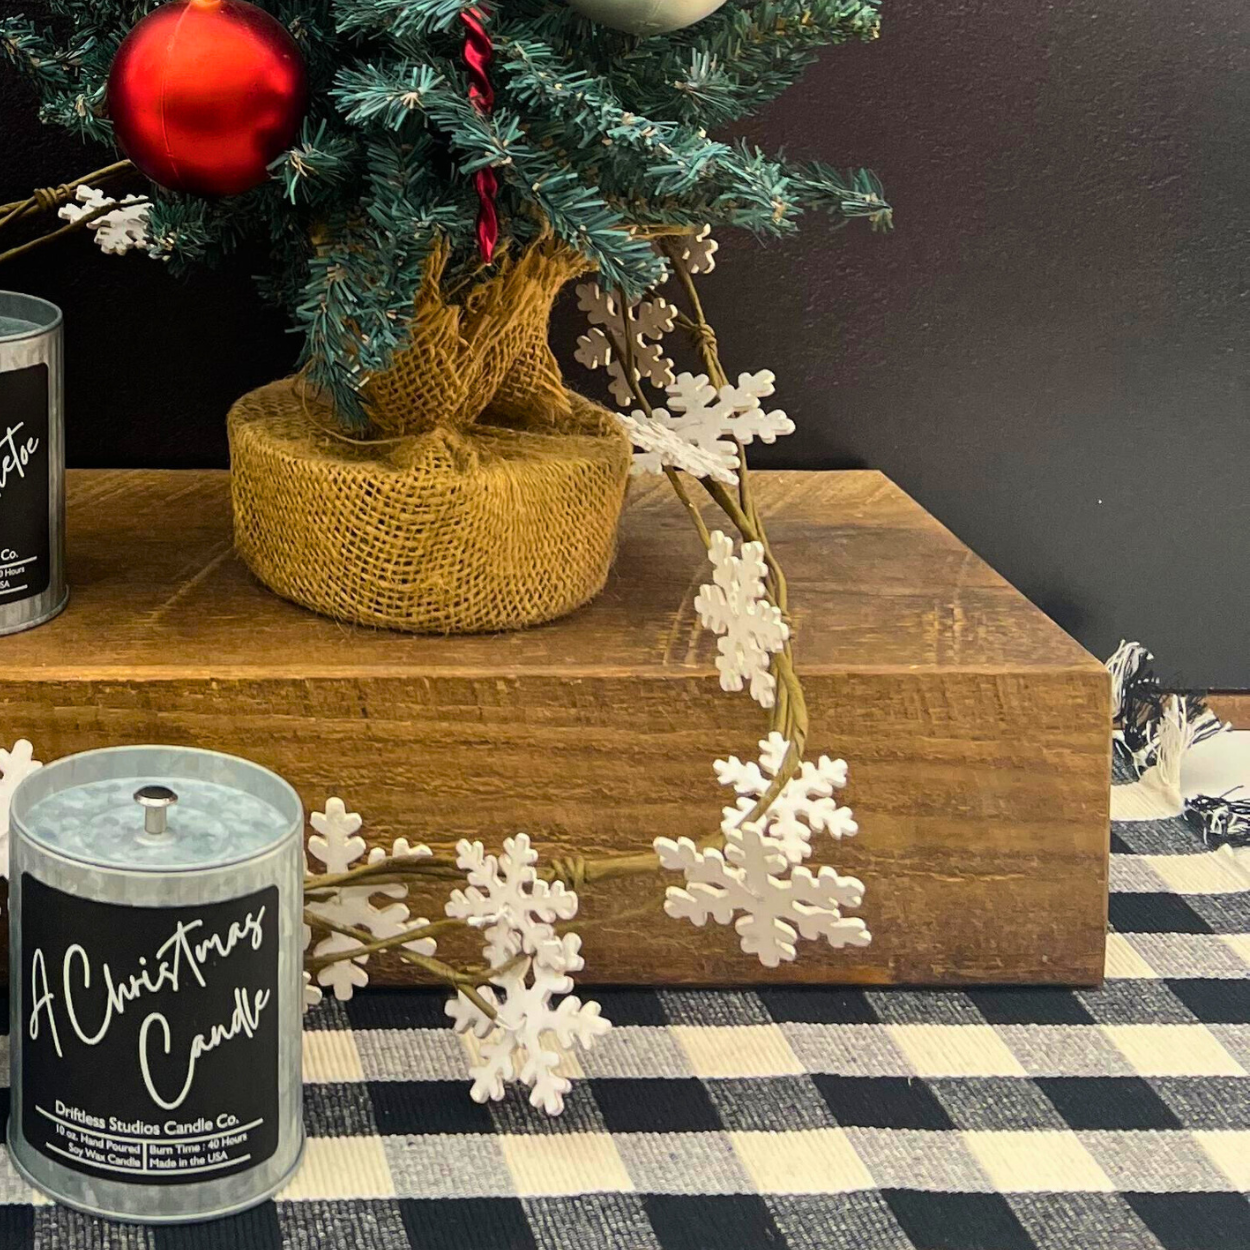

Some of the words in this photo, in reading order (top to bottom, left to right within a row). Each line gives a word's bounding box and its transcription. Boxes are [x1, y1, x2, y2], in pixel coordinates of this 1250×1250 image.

[0, 548, 19, 561] Co.
[4, 566, 25, 576] Hours
[29, 948, 64, 1057] A
[63, 905, 266, 1046] Christmas
[138, 987, 271, 1111] Candle
[55, 1099, 106, 1129] Driftless
[109, 1116, 160, 1135] Studios
[164, 1117, 214, 1135] Candle
[216, 1113, 239, 1128] Co.
[150, 1144, 174, 1155] Burn
[174, 1143, 201, 1154] Time
[207, 1139, 220, 1150] 40
[221, 1132, 247, 1147] Hours
[84, 1146, 106, 1162] Wax
[107, 1153, 141, 1167] Candle
[150, 1157, 177, 1168] Made
[178, 1156, 188, 1167] in
[189, 1154, 205, 1165] the
[207, 1150, 228, 1163] USA
